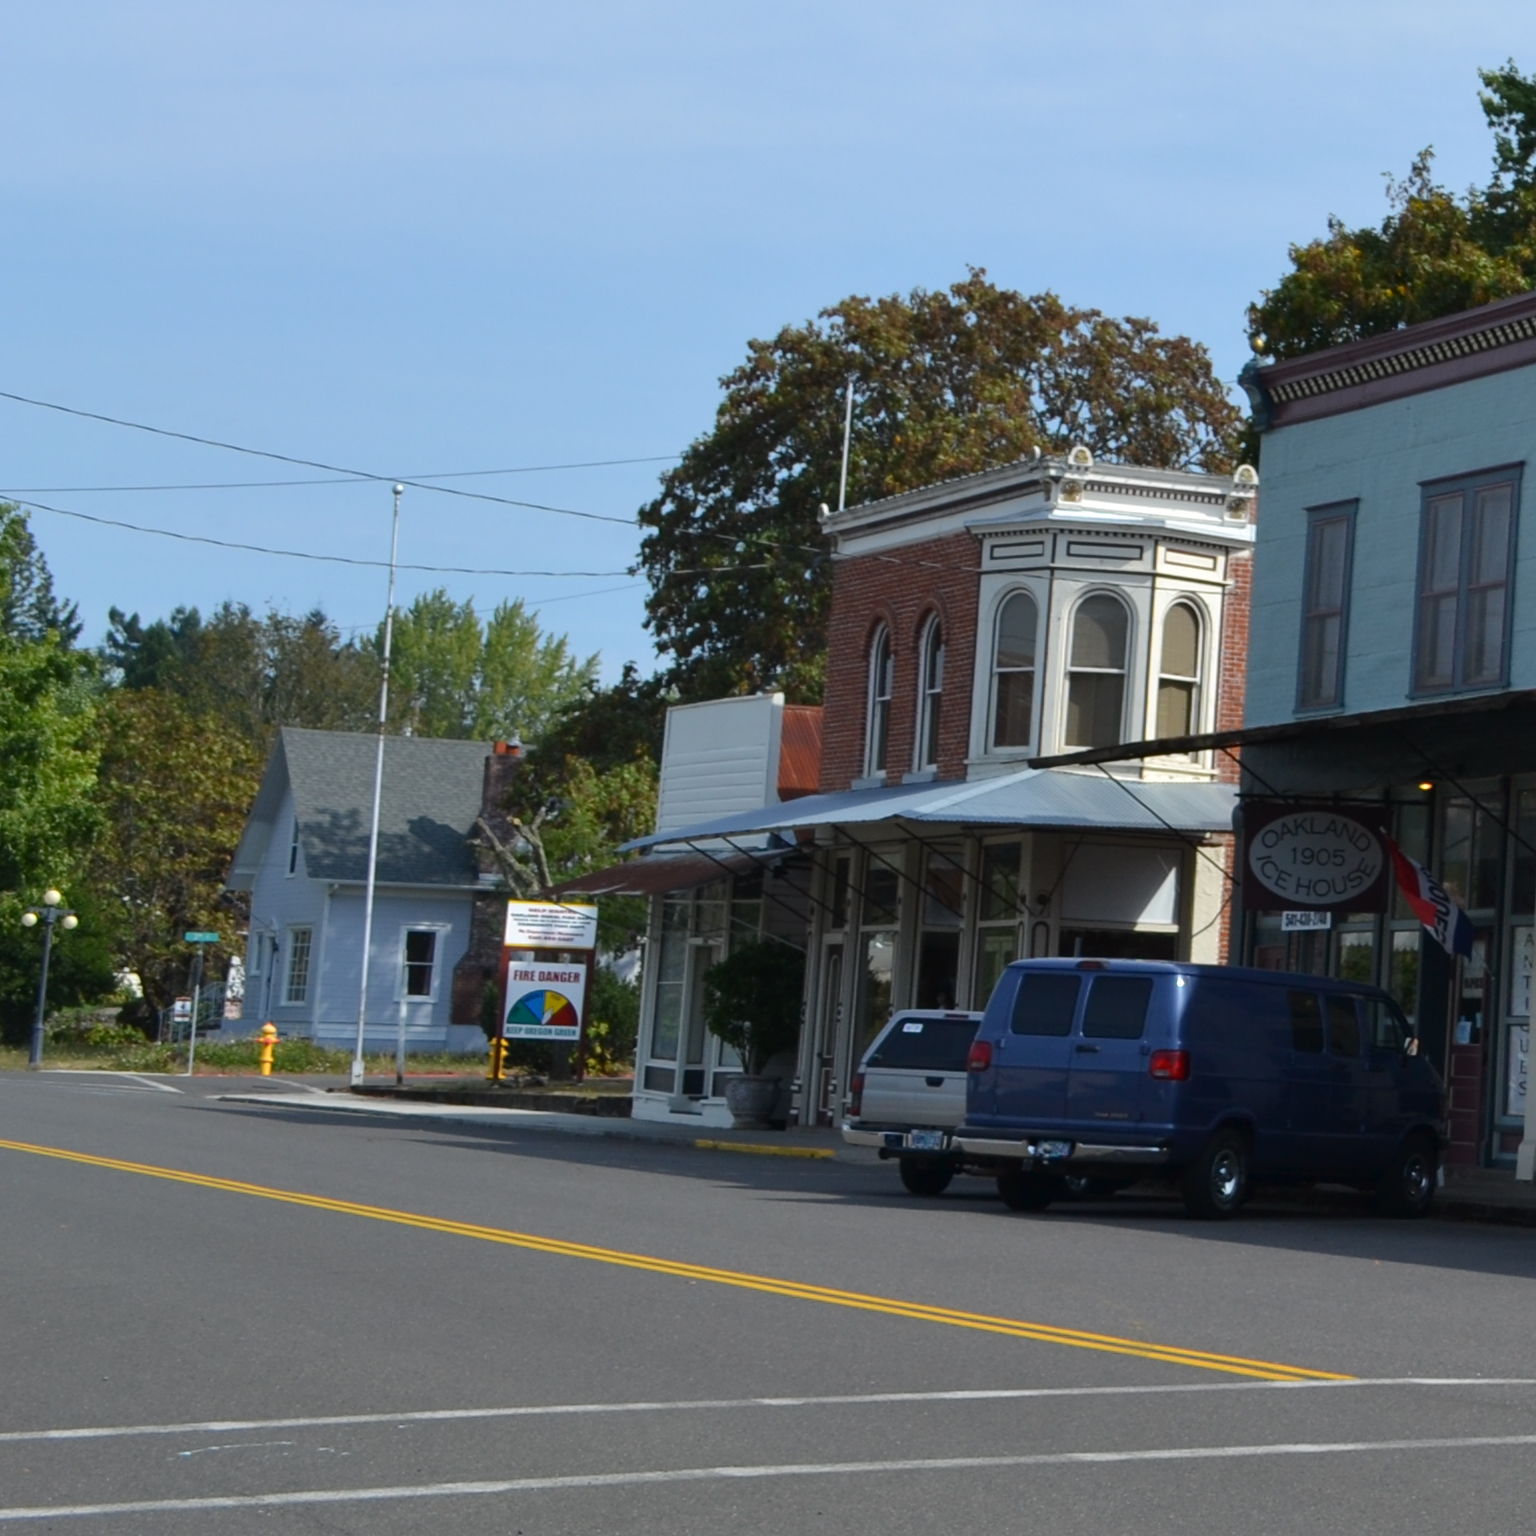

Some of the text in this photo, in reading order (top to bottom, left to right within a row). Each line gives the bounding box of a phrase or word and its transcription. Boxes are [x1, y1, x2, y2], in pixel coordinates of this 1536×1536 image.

[1261, 815, 1371, 853] OAKLAND
[1291, 846, 1346, 867] 1905
[1256, 855, 1377, 897] ICE HOUSE
[513, 969, 581, 983] FIRE DANGER
